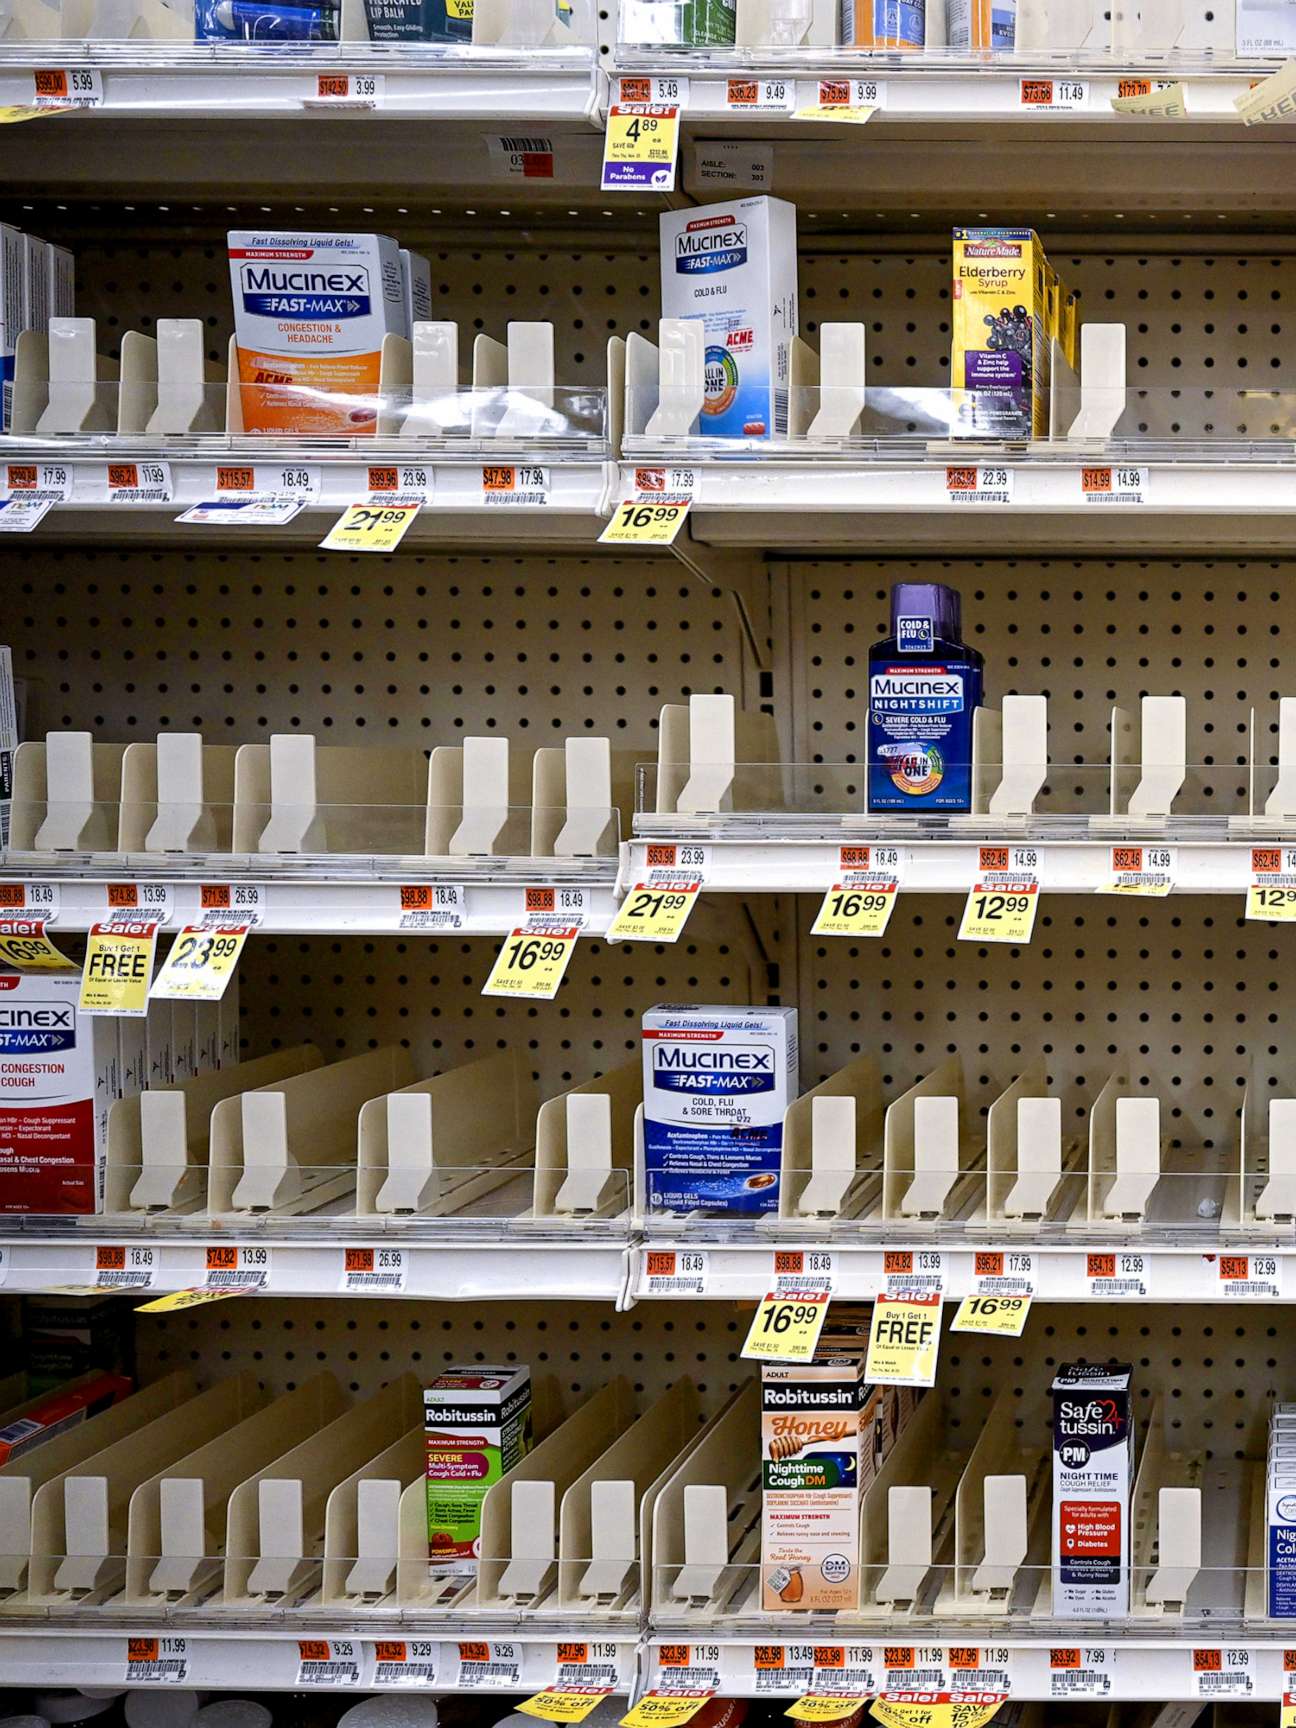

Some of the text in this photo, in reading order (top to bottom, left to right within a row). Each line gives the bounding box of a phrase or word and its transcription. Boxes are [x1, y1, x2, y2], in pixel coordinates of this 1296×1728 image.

[370, 6, 404, 18] LIP BALM
[73, 75, 92, 90] 5.99
[659, 84, 678, 98] 5.49
[766, 85, 785, 99] 9.49
[858, 86, 876, 100] 9.99
[1059, 86, 1083, 101] 11.49
[679, 232, 744, 254] Mucinex
[959, 265, 1025, 280] Elderberry
[247, 269, 363, 291] Mucinex
[979, 278, 1008, 288] Syrup
[694, 285, 727, 297] COLD & FLU
[271, 298, 344, 312] FAST-MAX
[278, 323, 341, 333] CONGESTION &
[288, 334, 333, 344] HEADACHE
[43, 471, 66, 486] 17.99
[281, 471, 309, 487] 18.49
[403, 472, 426, 486] 23.99
[520, 470, 544, 485] 17.99
[983, 472, 1007, 486] 22.99
[901, 621, 920, 629] COLD
[902, 630, 916, 639] FLU
[874, 680, 959, 695] Mucinex
[875, 699, 959, 709] NIGHTSHIFT
[904, 765, 928, 777] ONE
[681, 850, 704, 864] 23.99
[235, 890, 258, 904] 26.99
[89, 954, 147, 978] FREE
[658, 1048, 769, 1069] Mucinex
[1, 1064, 65, 1074] CONGESTION
[1, 1077, 35, 1087] COUGH
[678, 1075, 748, 1089] FAST-MAX
[692, 1097, 734, 1108] COLD, FLU
[682, 1107, 746, 1117] & SORE THROAT
[130, 1252, 153, 1265] 18.49
[1009, 1257, 1031, 1271] 17.99
[1121, 1258, 1143, 1272] 12.99
[764, 1389, 854, 1405] Robitussin
[425, 1408, 496, 1422] Robitussin
[1060, 1401, 1103, 1419] Safe
[772, 1415, 848, 1442] Honey
[428, 1454, 463, 1463] SEVERE
[1063, 1446, 1086, 1462] PM
[768, 1462, 824, 1475] Nighttime
[768, 1474, 826, 1489] Cough DM
[1060, 1472, 1118, 1480] NIGHT TIME
[1078, 1523, 1094, 1531] High
[161, 1639, 185, 1652] 11.99
[335, 1642, 353, 1655] 9.29
[592, 1643, 616, 1657] 11.99
[789, 1647, 813, 1661] 13.49
[1086, 1649, 1105, 1664] 7.99
